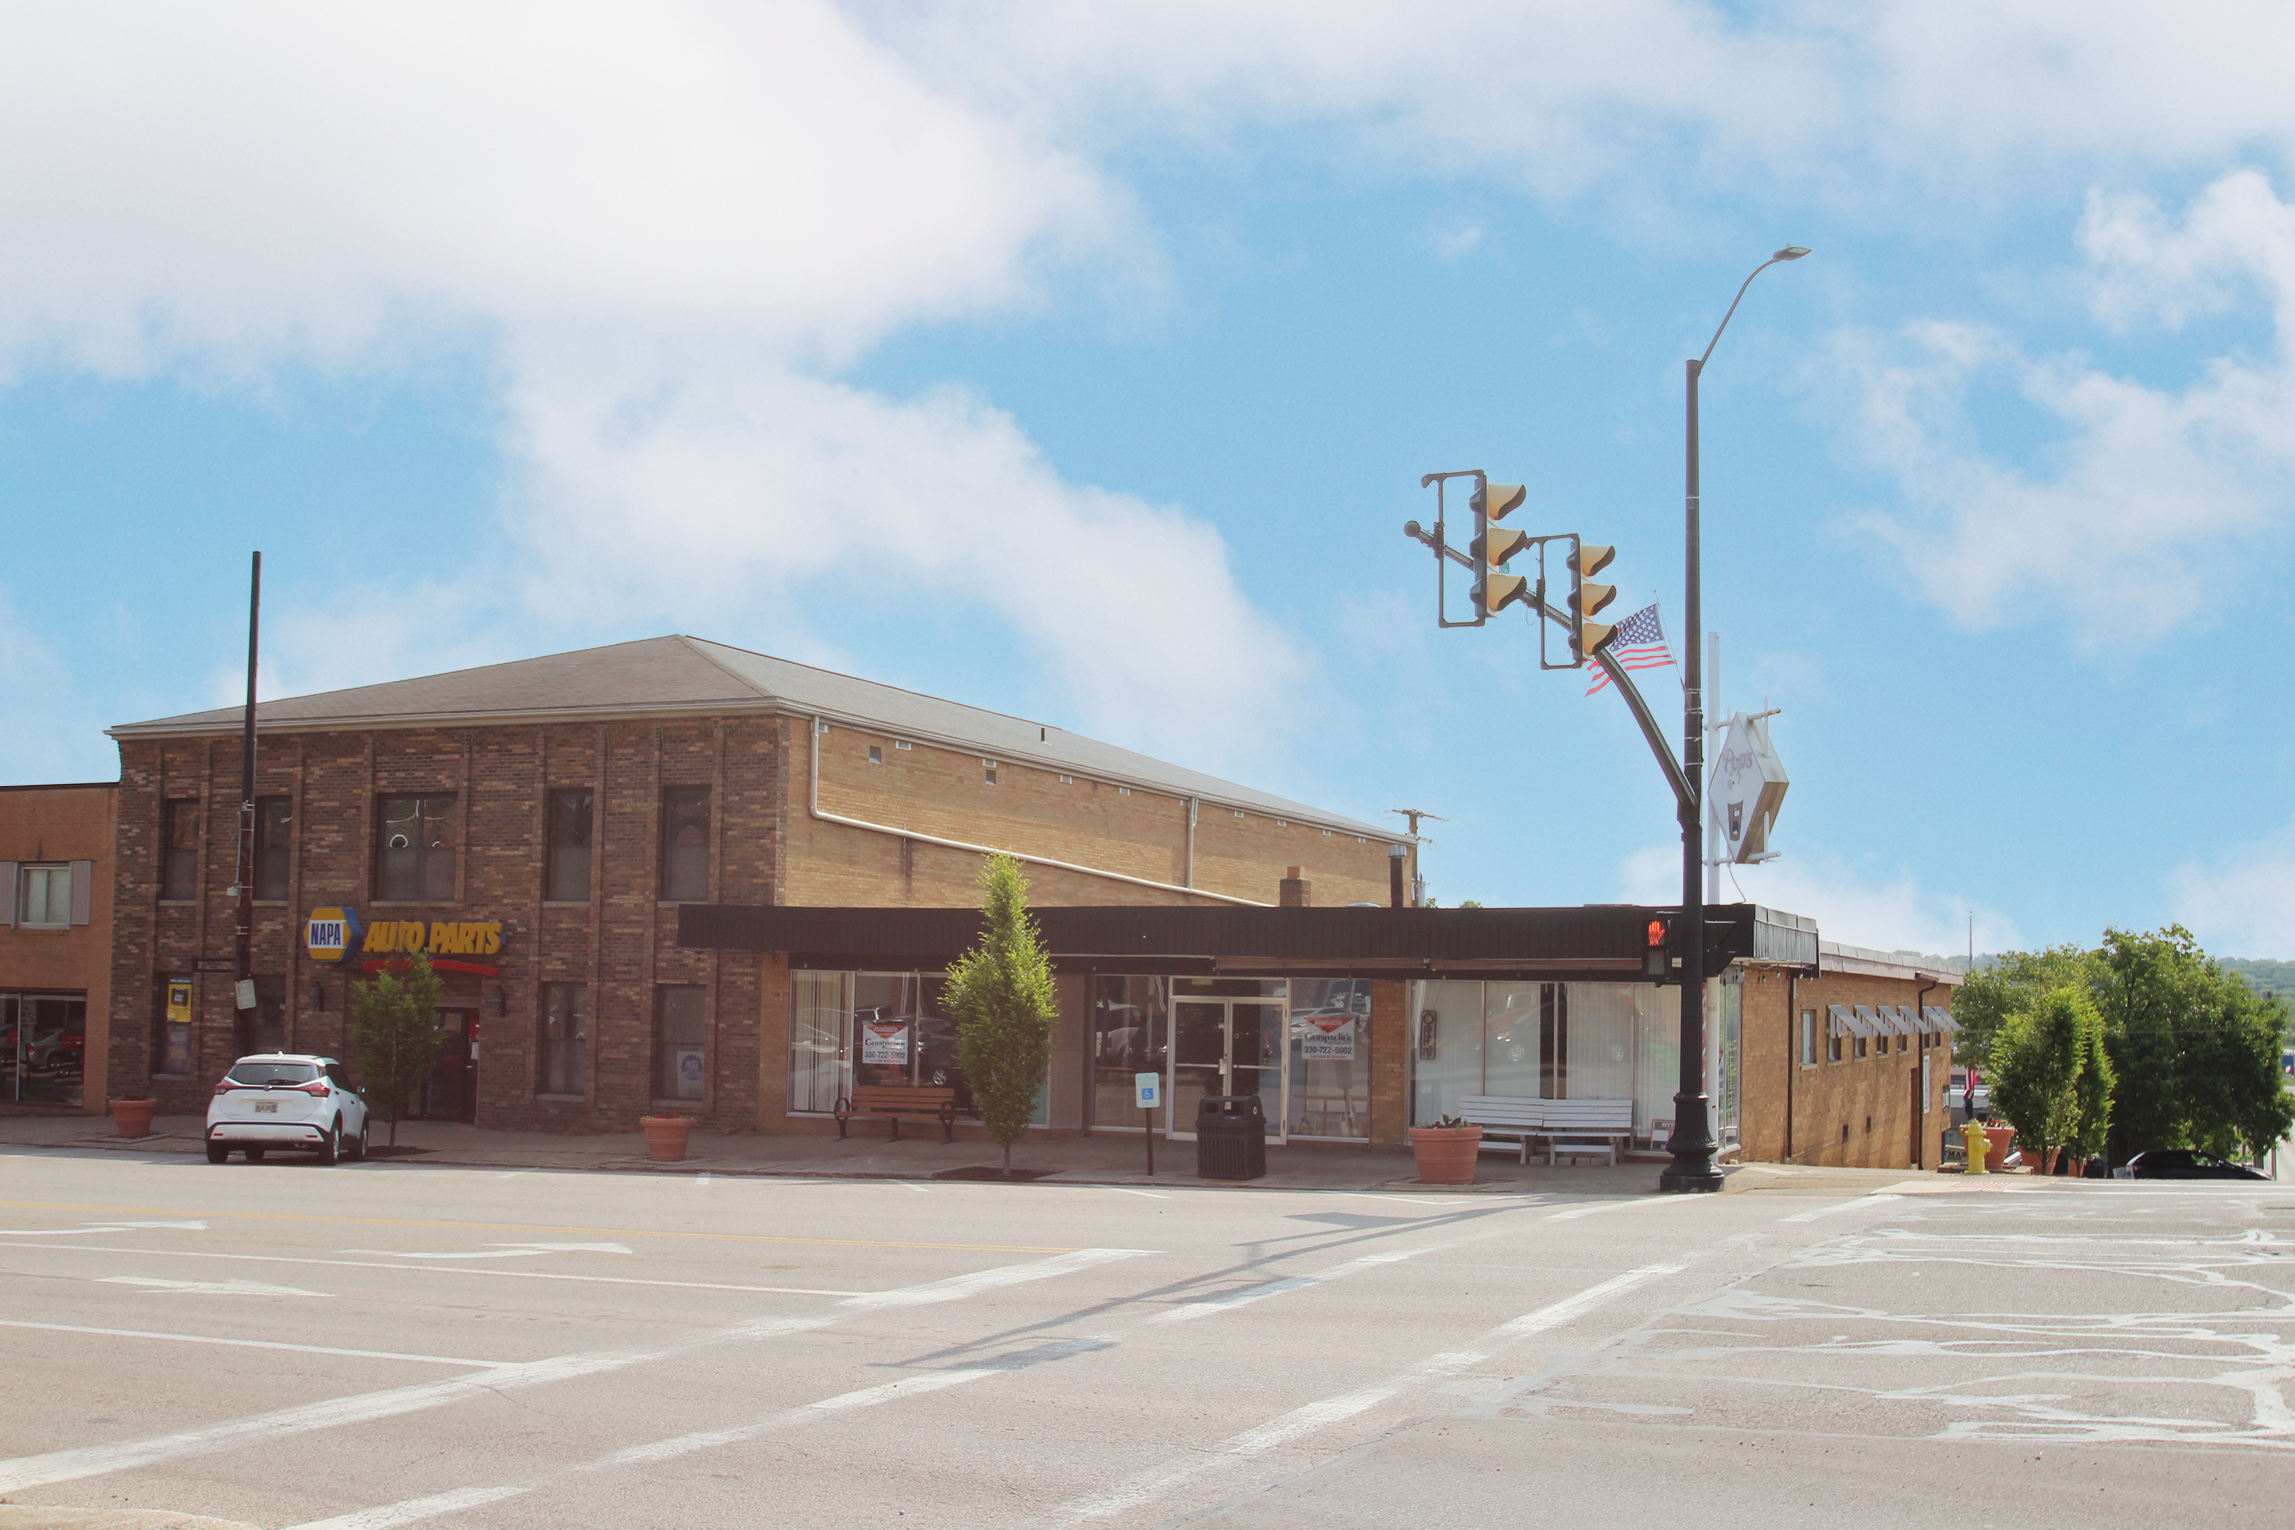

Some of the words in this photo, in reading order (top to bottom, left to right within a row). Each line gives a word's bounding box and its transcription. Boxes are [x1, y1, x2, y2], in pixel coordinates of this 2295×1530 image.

[1722, 748, 1754, 775] Pop's
[310, 923, 341, 946] NAPA
[362, 921, 426, 953] AUTO
[428, 921, 503, 955] PARTS
[1314, 1018, 1343, 1026] Available
[873, 1025, 898, 1033] Available
[1422, 1013, 1435, 1057] OPEN
[1303, 1046, 1352, 1055] 330-722-5002
[684, 1060, 699, 1069] ASE
